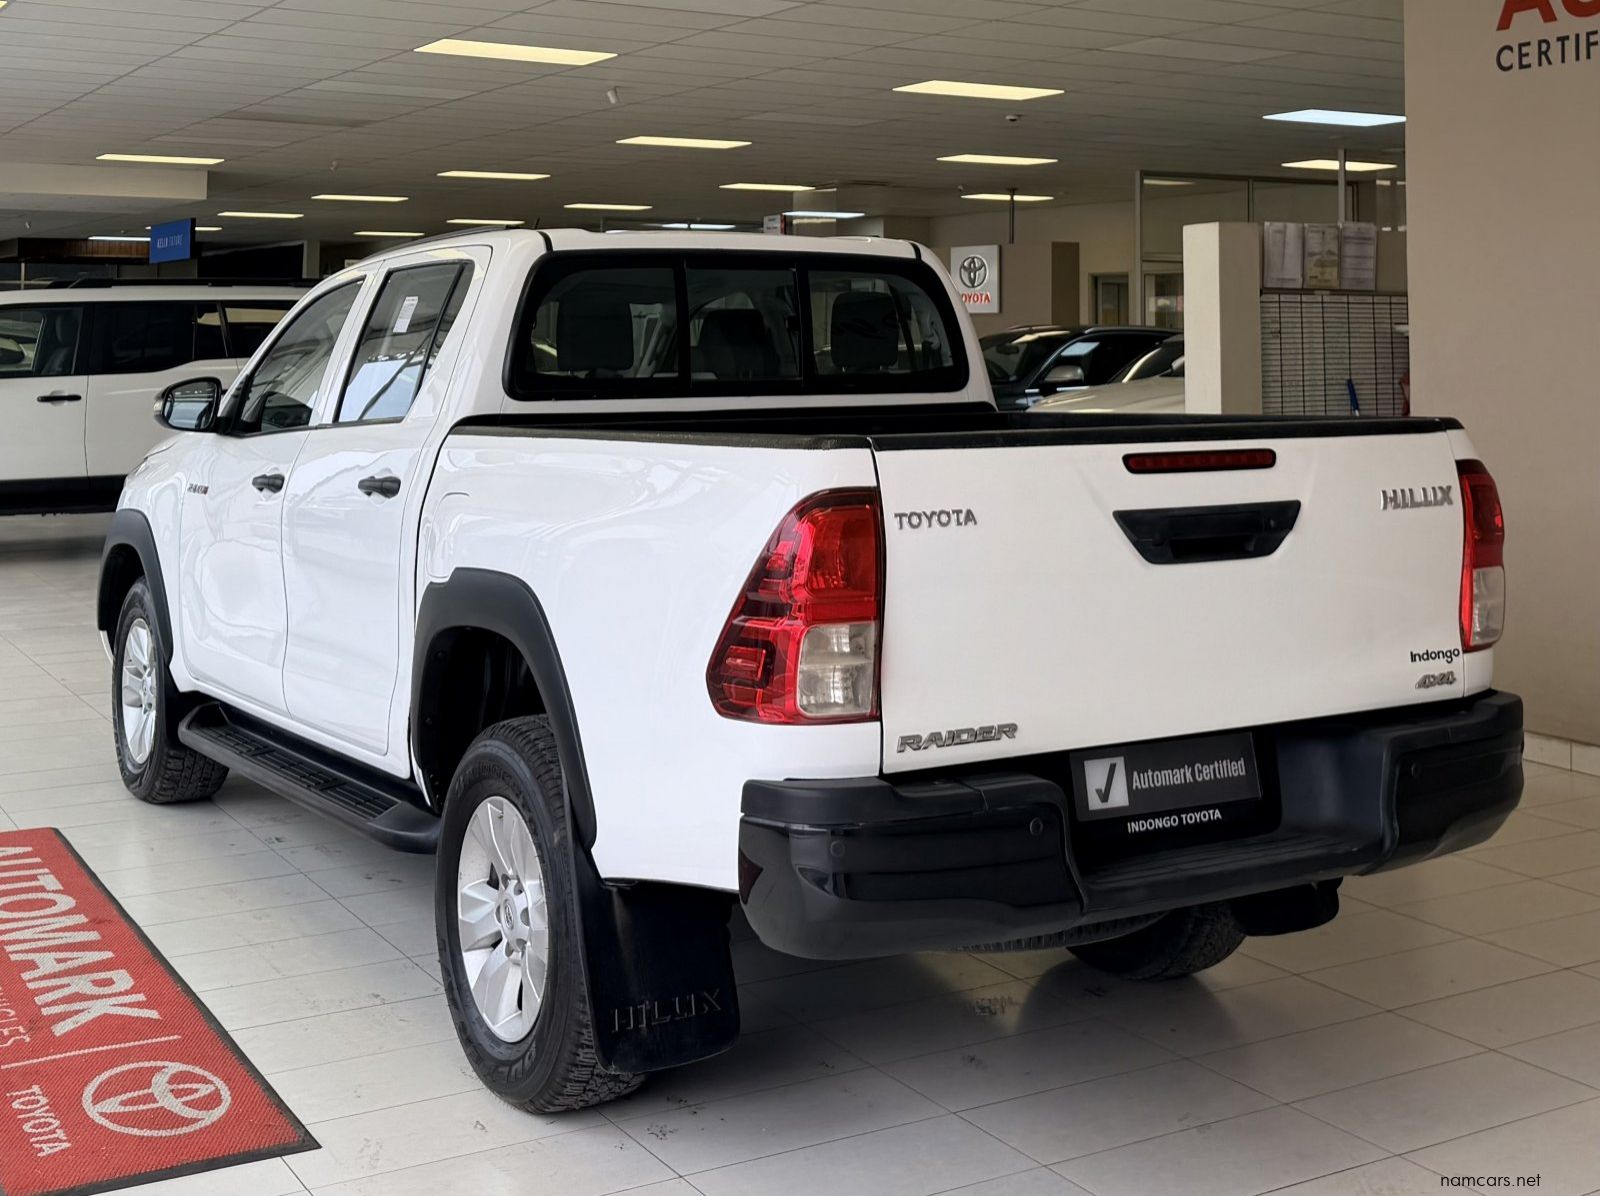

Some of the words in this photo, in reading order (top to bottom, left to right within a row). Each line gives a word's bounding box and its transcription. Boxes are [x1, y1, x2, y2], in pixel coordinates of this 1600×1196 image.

[961, 292, 991, 304] OYOTA
[1380, 485, 1453, 510] HILUX
[893, 508, 977, 530] TOYOTA
[1410, 648, 1461, 664] Indongo
[897, 722, 1018, 753] RAIDER
[1132, 764, 1193, 790] Automark
[1194, 757, 1246, 782] Certified
[1127, 815, 1179, 834] INDONGO
[1180, 808, 1222, 826] TOYOTA
[611, 988, 721, 1033] HILUX
[7, 1084, 72, 1157] TOYOTA
